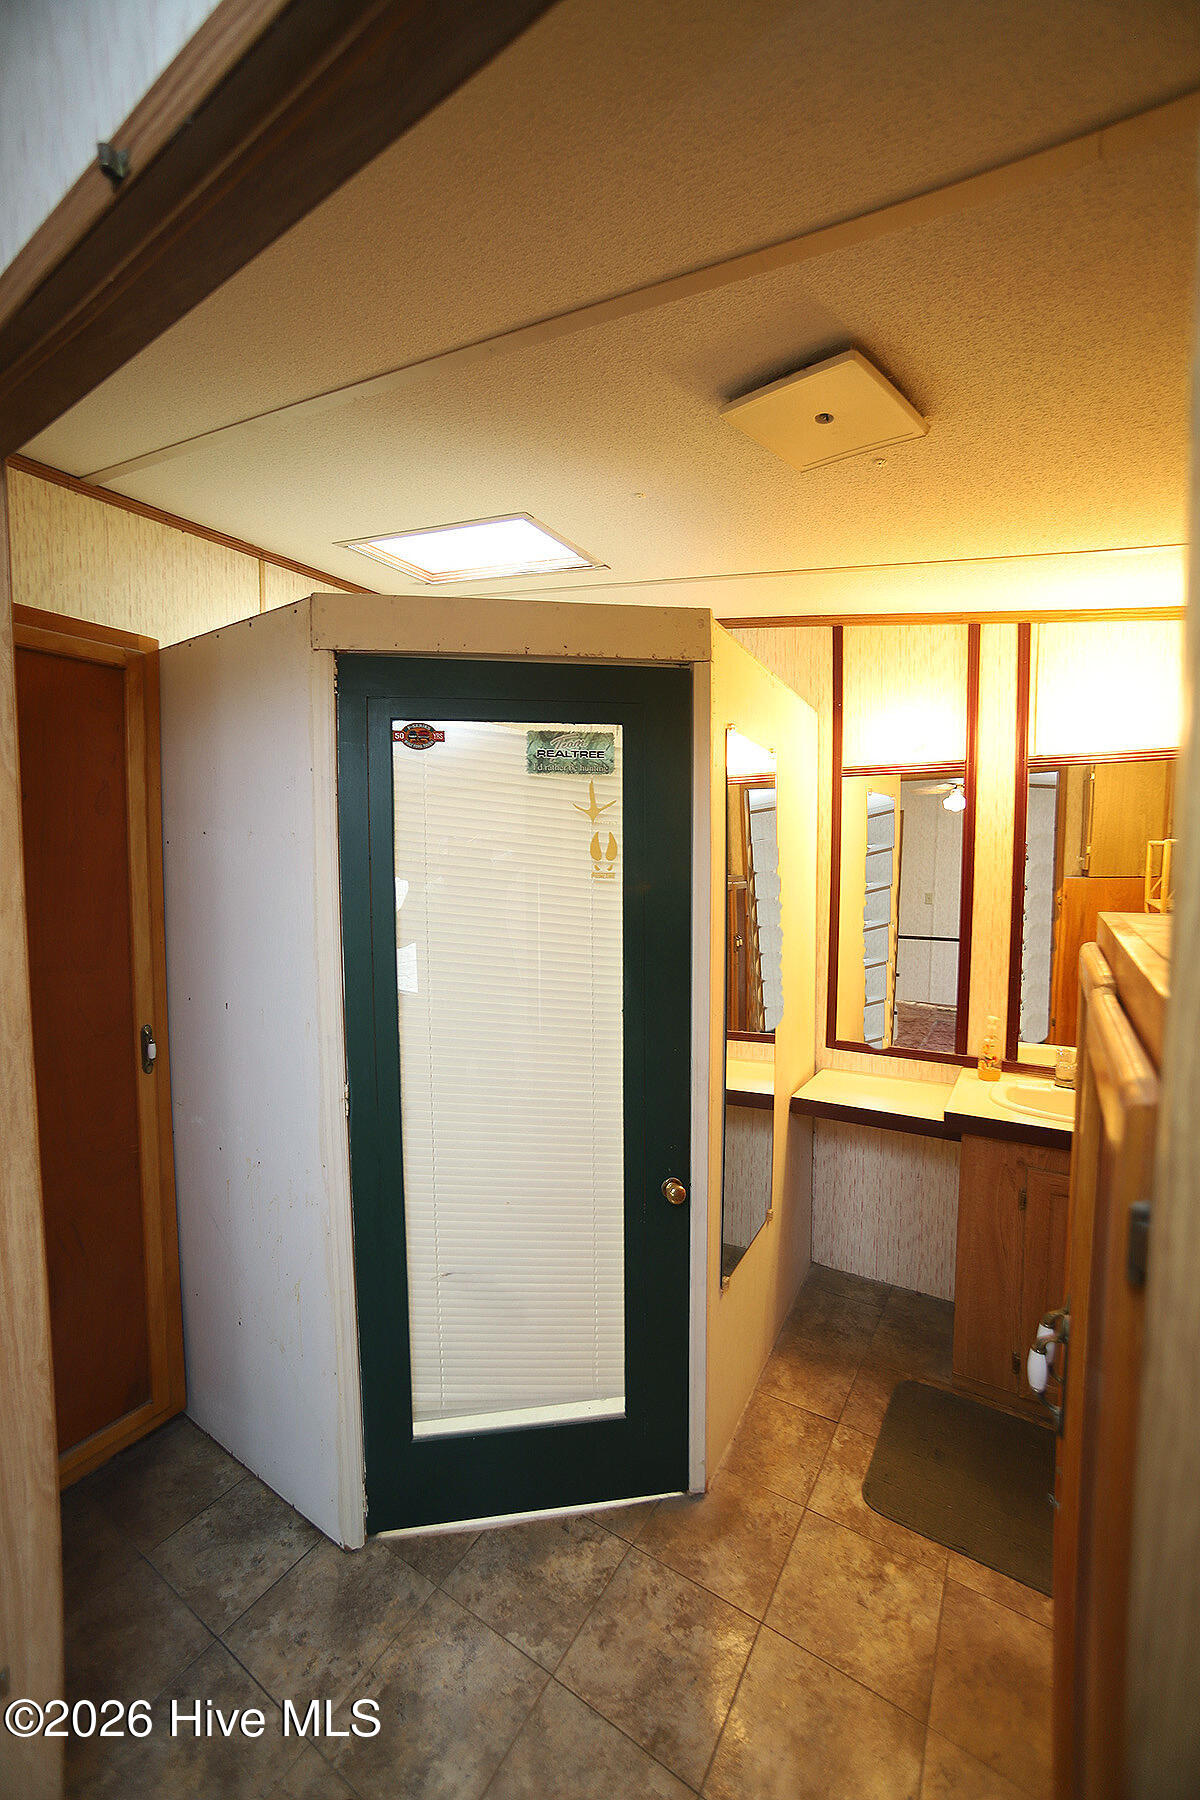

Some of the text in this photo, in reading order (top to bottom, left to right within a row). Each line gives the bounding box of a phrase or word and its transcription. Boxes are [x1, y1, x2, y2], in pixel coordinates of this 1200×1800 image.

[394, 732, 405, 740] 50
[550, 733, 588, 750] Team
[536, 749, 605, 759] REALTREE
